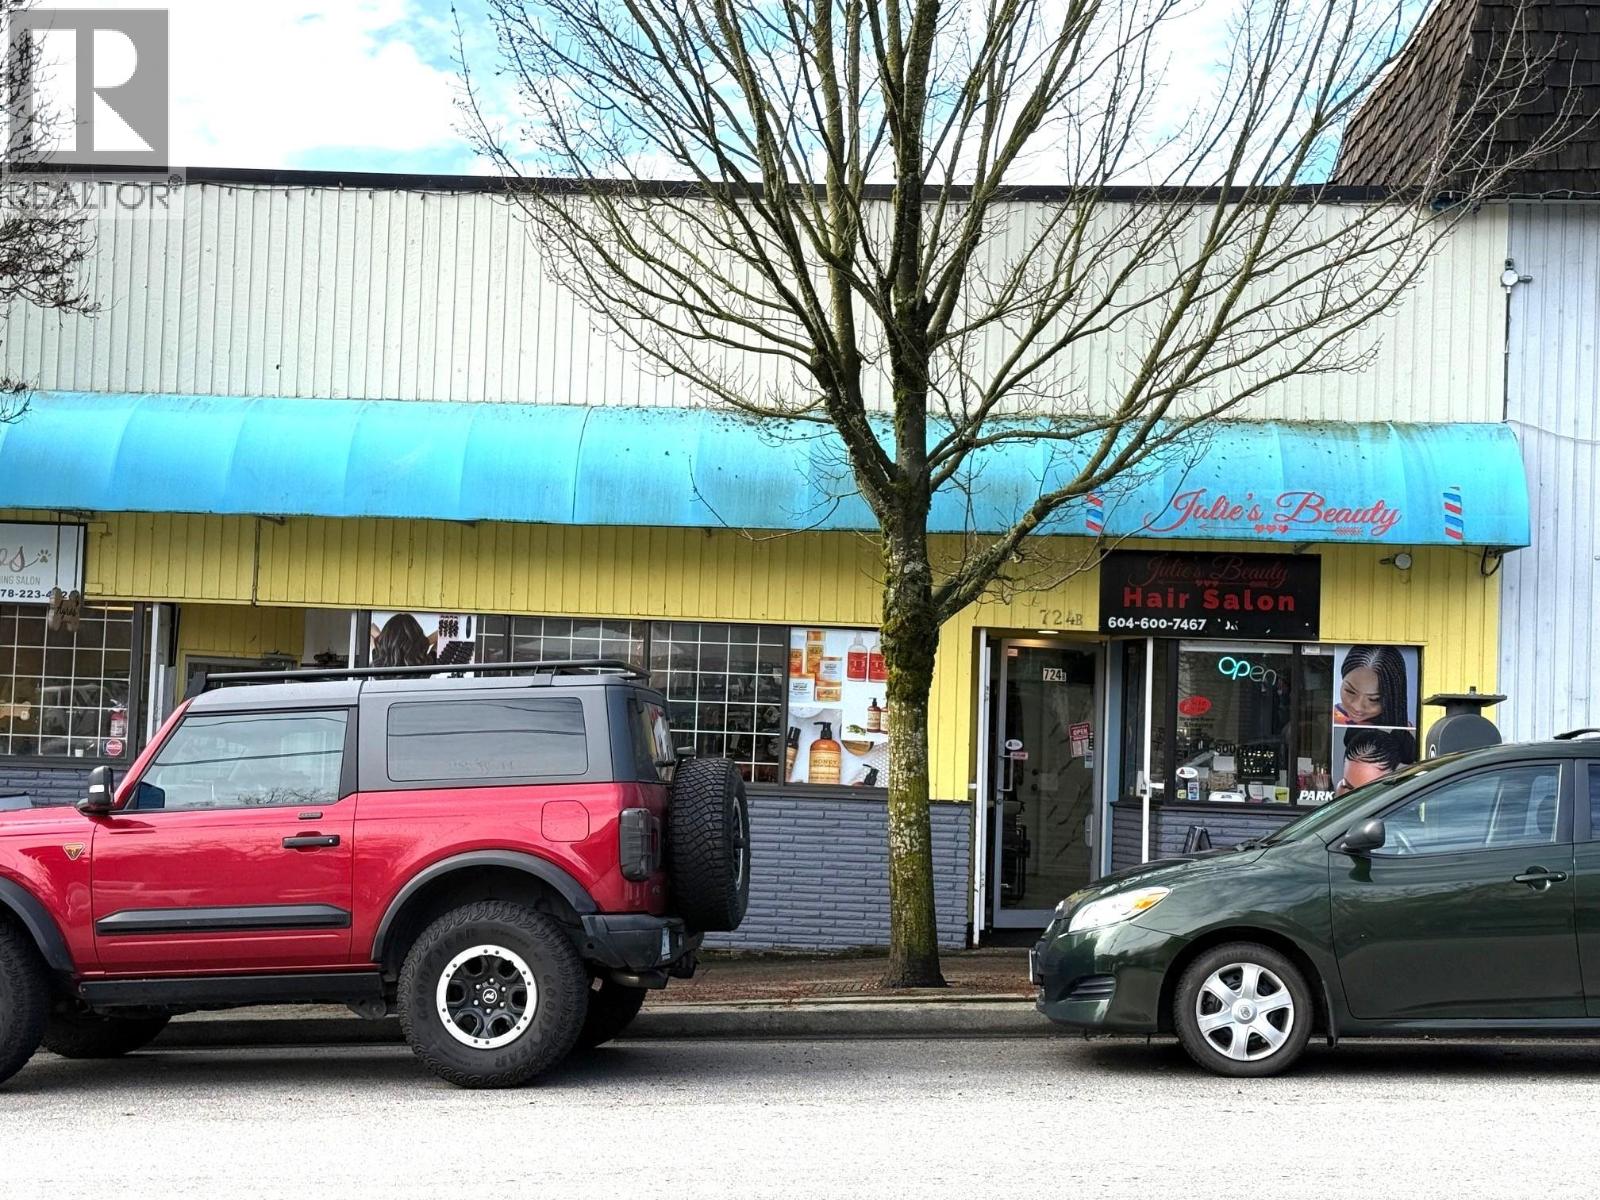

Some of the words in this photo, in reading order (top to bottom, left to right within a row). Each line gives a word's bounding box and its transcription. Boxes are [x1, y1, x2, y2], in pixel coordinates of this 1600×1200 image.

[1143, 489, 1264, 533] Julie's
[1274, 492, 1402, 536] Beauty
[1209, 555, 1289, 589] Beauty
[1122, 586, 1190, 609] Hair
[1203, 588, 1295, 611] Salon
[1040, 609, 1083, 625] 724B
[1108, 616, 1208, 630] 604-600-7467
